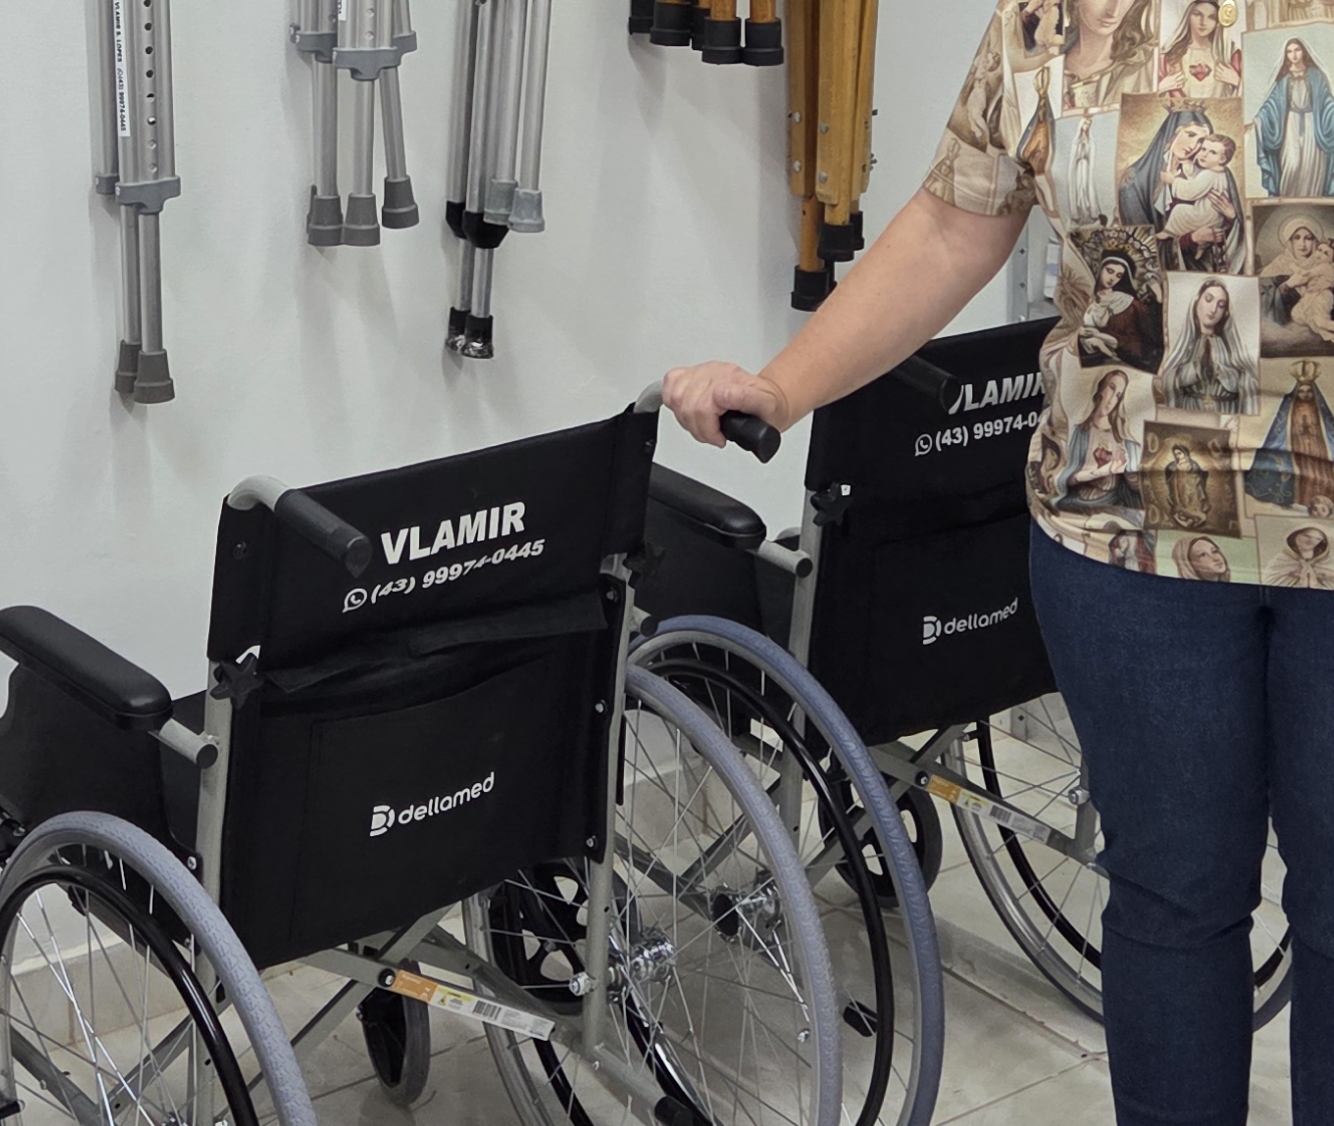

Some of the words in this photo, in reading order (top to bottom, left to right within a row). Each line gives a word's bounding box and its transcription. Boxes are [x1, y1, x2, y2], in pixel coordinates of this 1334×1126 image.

[935, 425, 969, 452] (43)
[380, 501, 526, 566] VLAMIR
[371, 576, 416, 604] (43)
[422, 539, 546, 589] 99974-0445
[944, 597, 1019, 635] dellamed
[397, 771, 495, 826] dellamed
